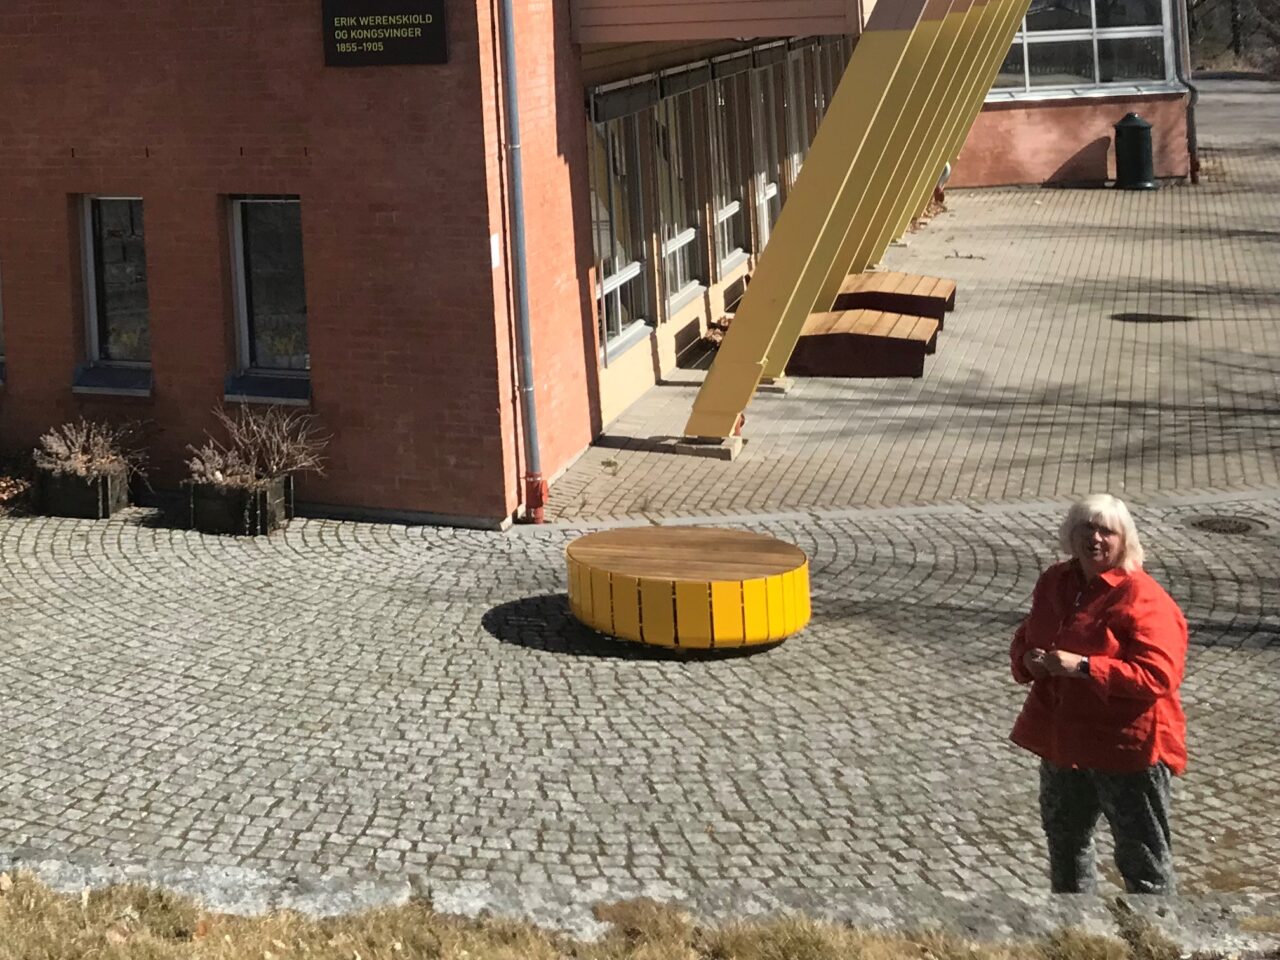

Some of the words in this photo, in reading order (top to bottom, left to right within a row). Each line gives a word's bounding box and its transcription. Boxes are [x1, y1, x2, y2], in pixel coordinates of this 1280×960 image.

[334, 16, 357, 26] ERIK
[359, 14, 432, 26] WERENSKIOLD
[335, 30, 348, 40] OG
[350, 27, 422, 39] KONGSVINGER
